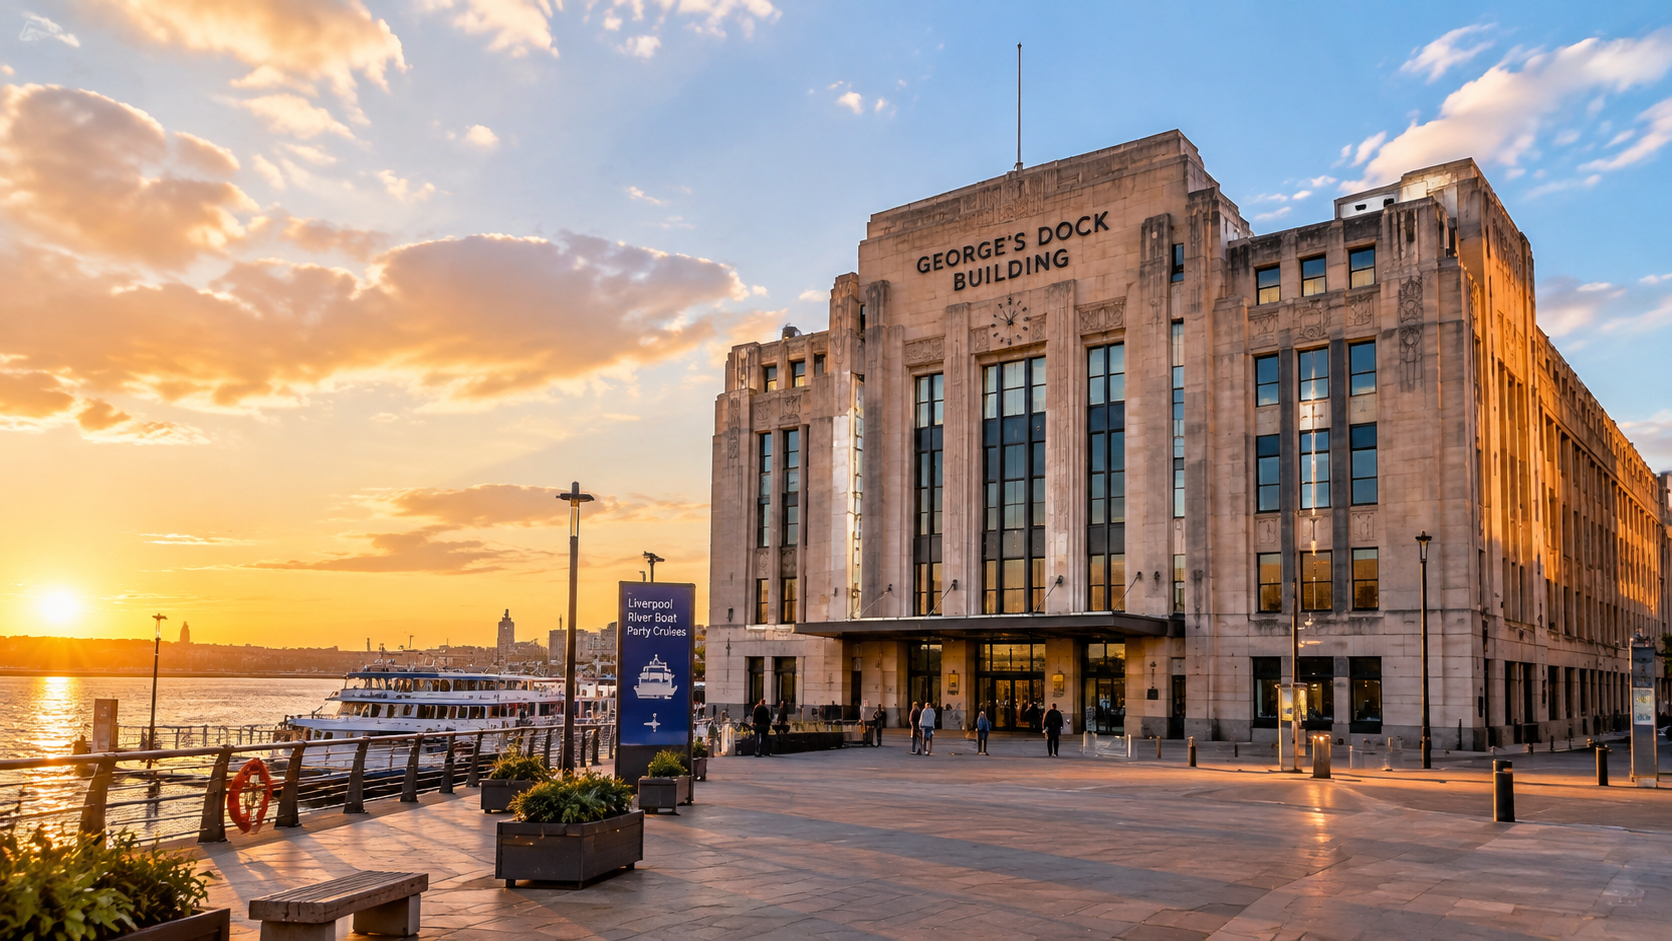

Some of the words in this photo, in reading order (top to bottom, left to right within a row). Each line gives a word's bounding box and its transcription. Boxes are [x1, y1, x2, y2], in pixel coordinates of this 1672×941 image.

[916, 232, 1026, 274] GEORGE'S
[1038, 210, 1110, 246] DOCK
[953, 248, 1069, 291] BUILDING
[628, 598, 673, 610] Liverpool
[655, 612, 677, 623] Boat
[627, 626, 651, 638] Party
[653, 626, 686, 636] Cruises
